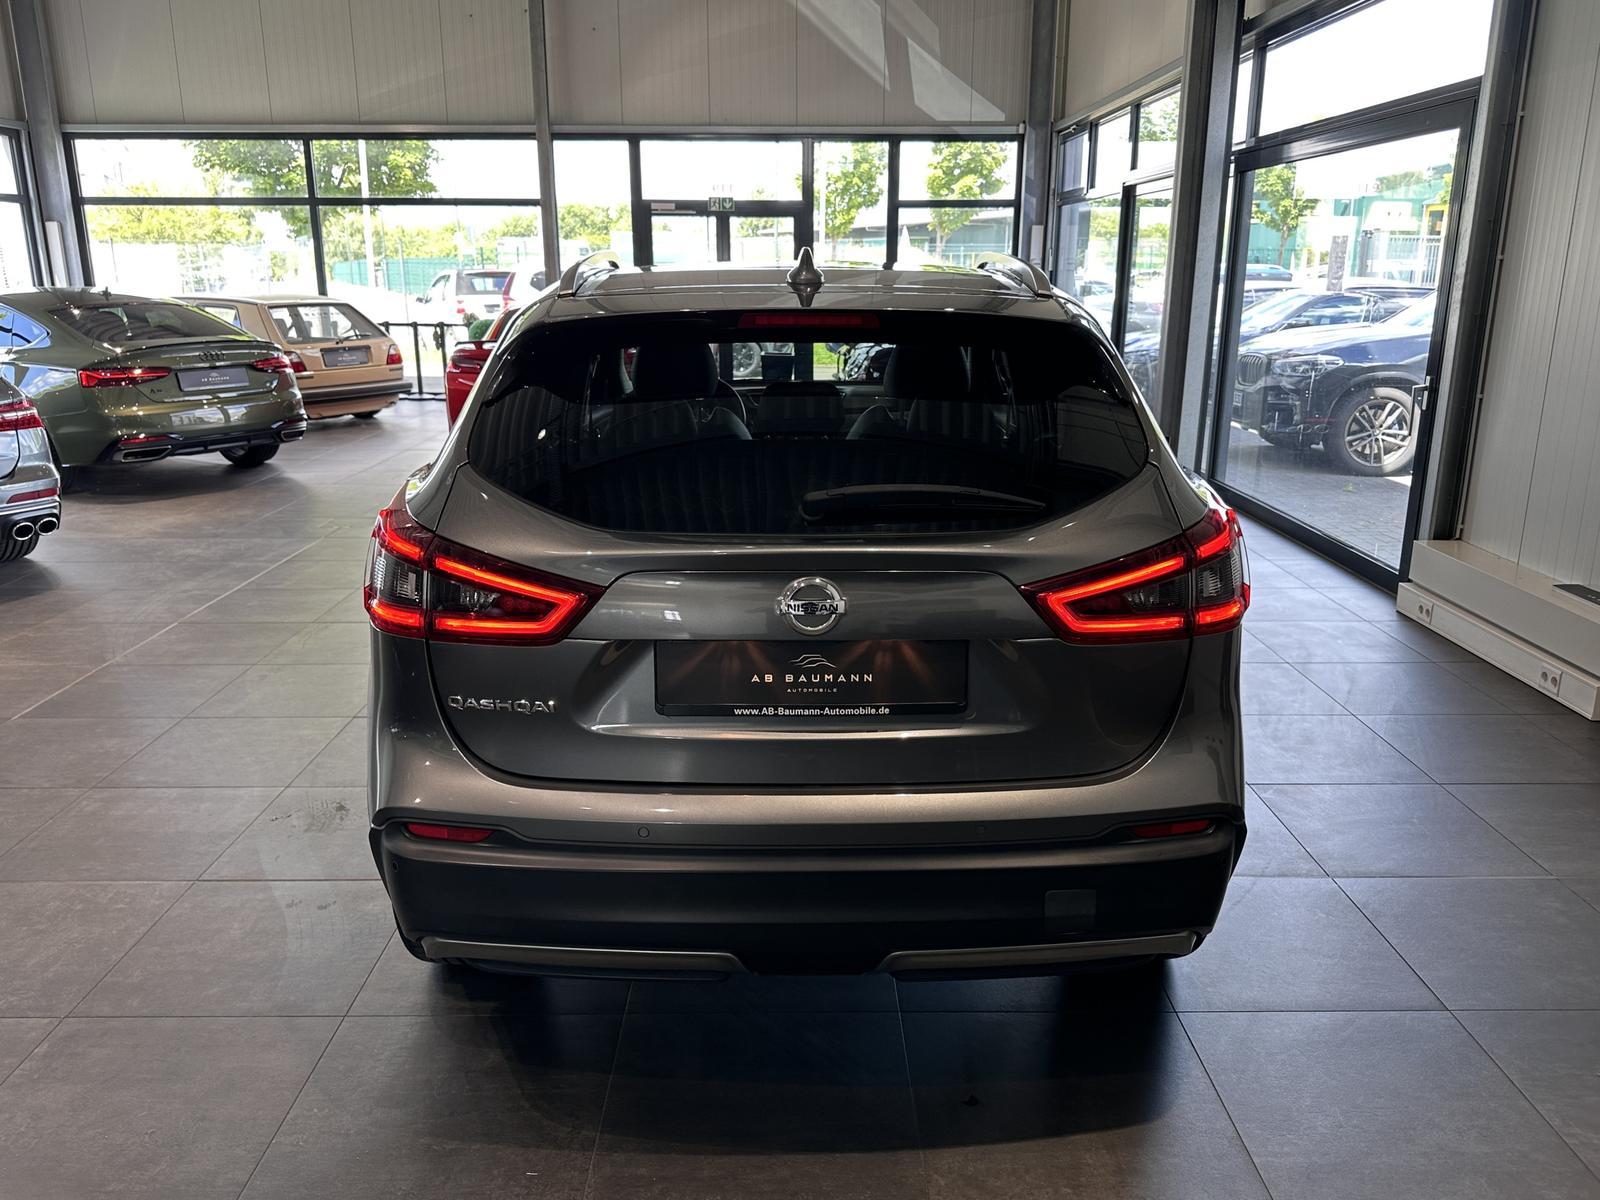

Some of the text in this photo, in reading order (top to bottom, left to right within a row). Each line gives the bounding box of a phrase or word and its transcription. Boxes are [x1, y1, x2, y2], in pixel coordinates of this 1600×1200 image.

[787, 603, 838, 612] NISSAN
[751, 674, 873, 683] AB BAUMANN
[447, 695, 556, 714] QASHQAI
[734, 706, 890, 716] www.AB-Baumann-Automobile.de
